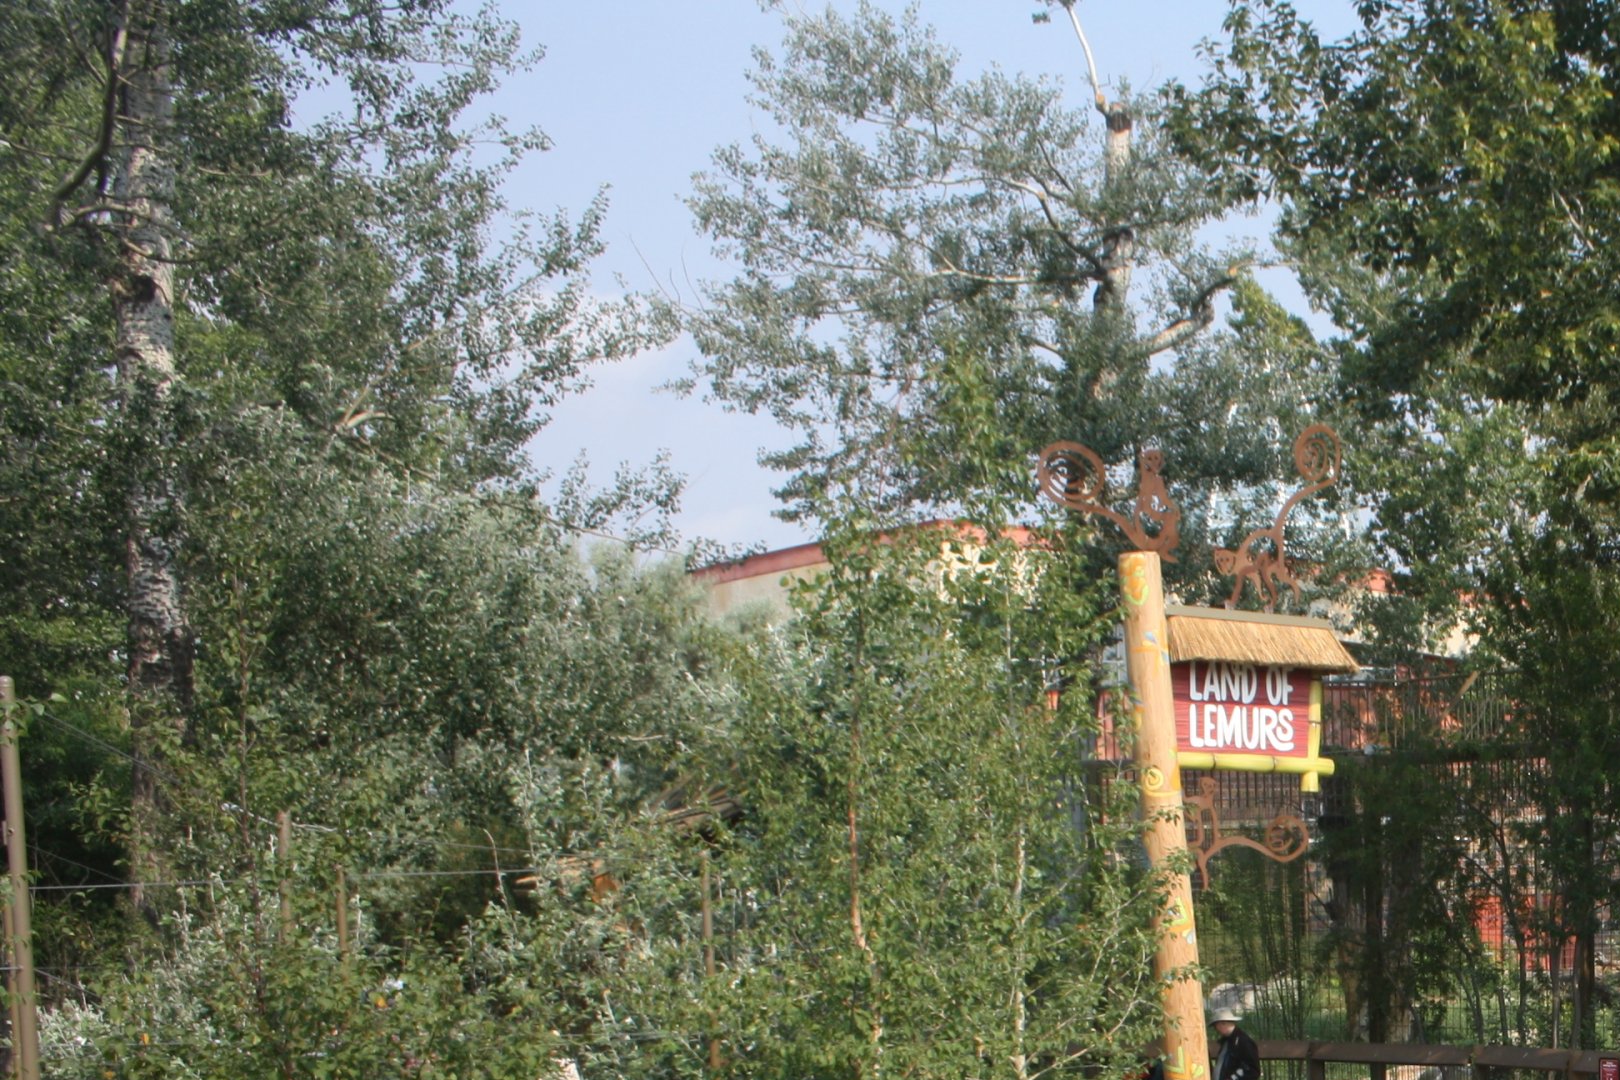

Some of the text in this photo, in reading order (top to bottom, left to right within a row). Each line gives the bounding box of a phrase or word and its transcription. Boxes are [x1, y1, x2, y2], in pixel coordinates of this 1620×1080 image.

[1189, 661, 1294, 705] LAND OF
[1188, 703, 1295, 751] LEMURS
